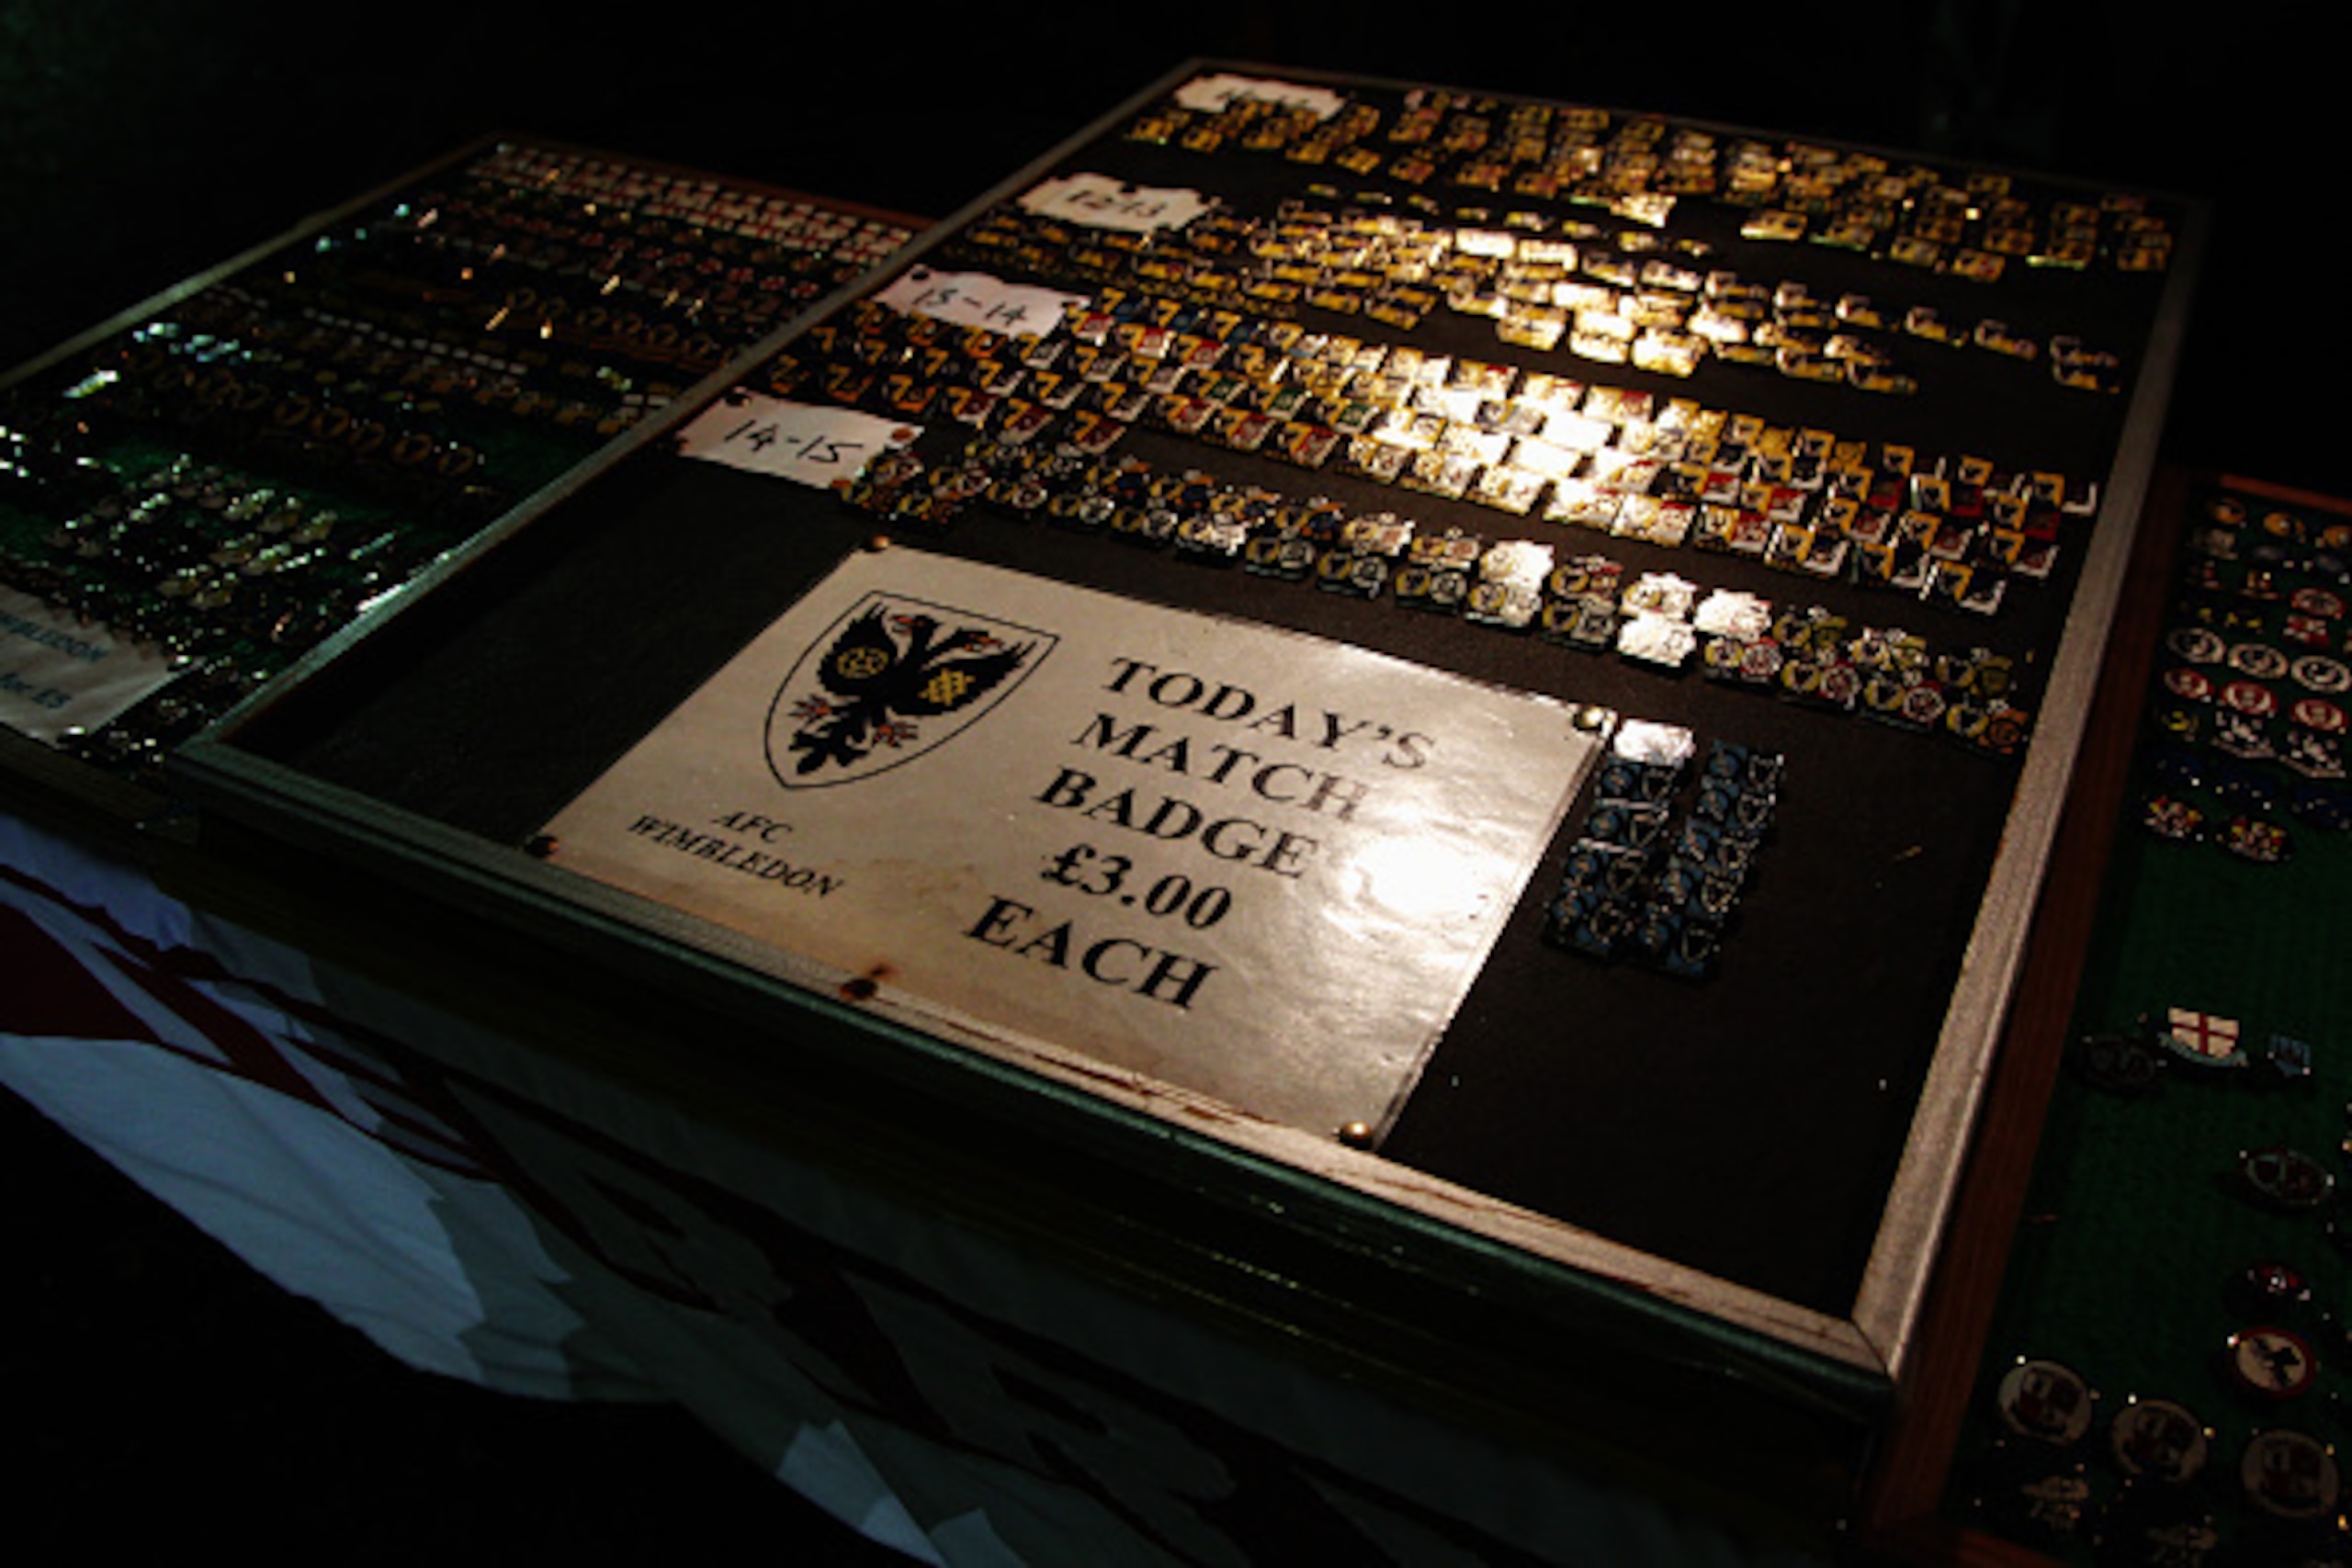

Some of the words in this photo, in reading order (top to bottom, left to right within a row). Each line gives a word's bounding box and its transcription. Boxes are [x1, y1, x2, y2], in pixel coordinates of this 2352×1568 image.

[723, 419, 865, 464] 14-15
[1102, 657, 1436, 770] TODAY'S
[1070, 712, 1371, 823] MATCH
[627, 815, 844, 897] WIMBLEDON
[709, 811, 793, 843] AFC
[1032, 765, 1319, 879] BADGE
[1039, 842, 1232, 931] £3.00
[961, 894, 1219, 1010] EACH
